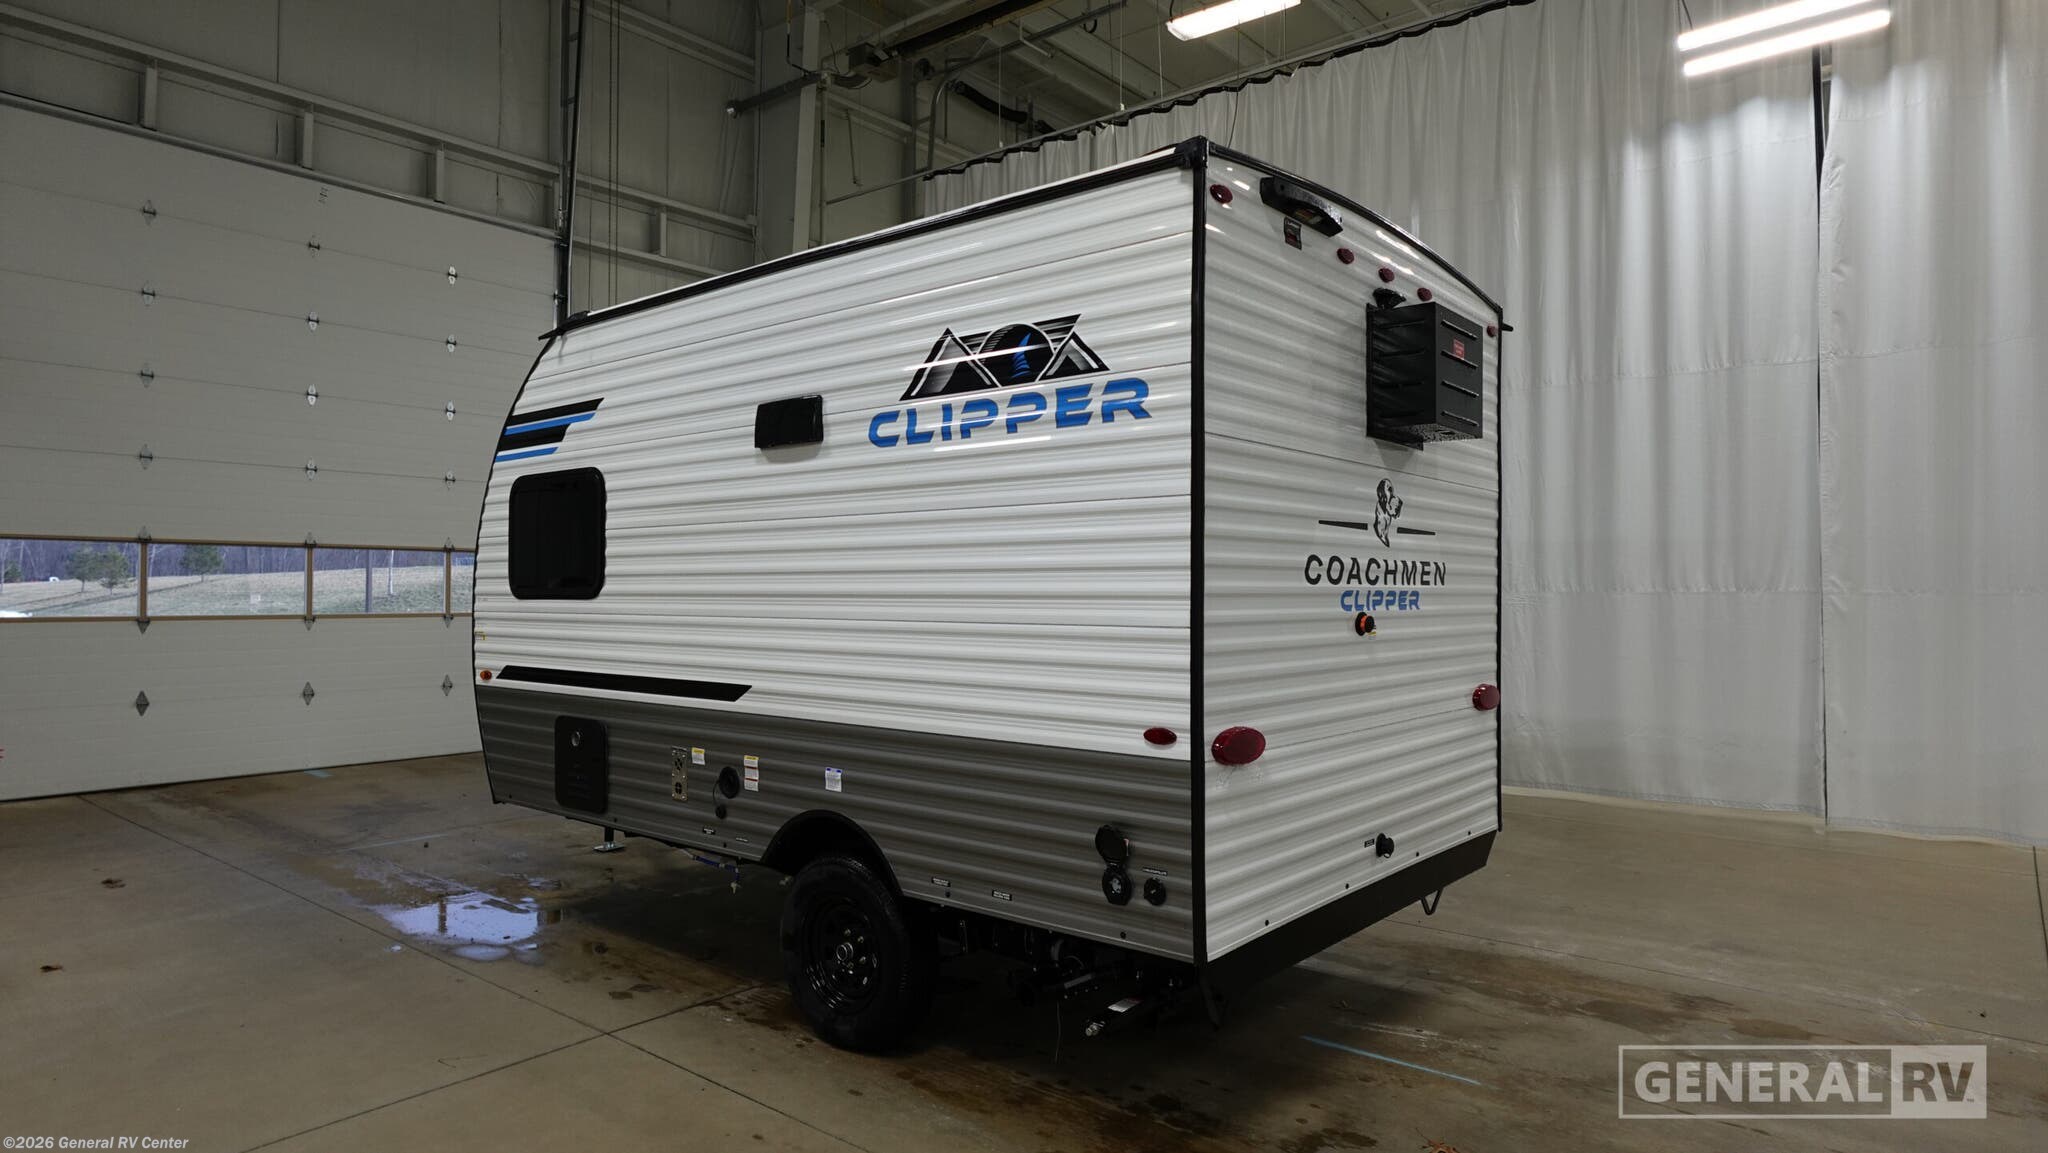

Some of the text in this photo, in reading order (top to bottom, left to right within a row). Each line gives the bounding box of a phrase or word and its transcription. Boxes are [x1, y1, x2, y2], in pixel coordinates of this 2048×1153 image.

[868, 377, 1152, 448] CLIPPER
[1304, 554, 1446, 586] COACHMEN
[1340, 590, 1421, 612] CLIPPER
